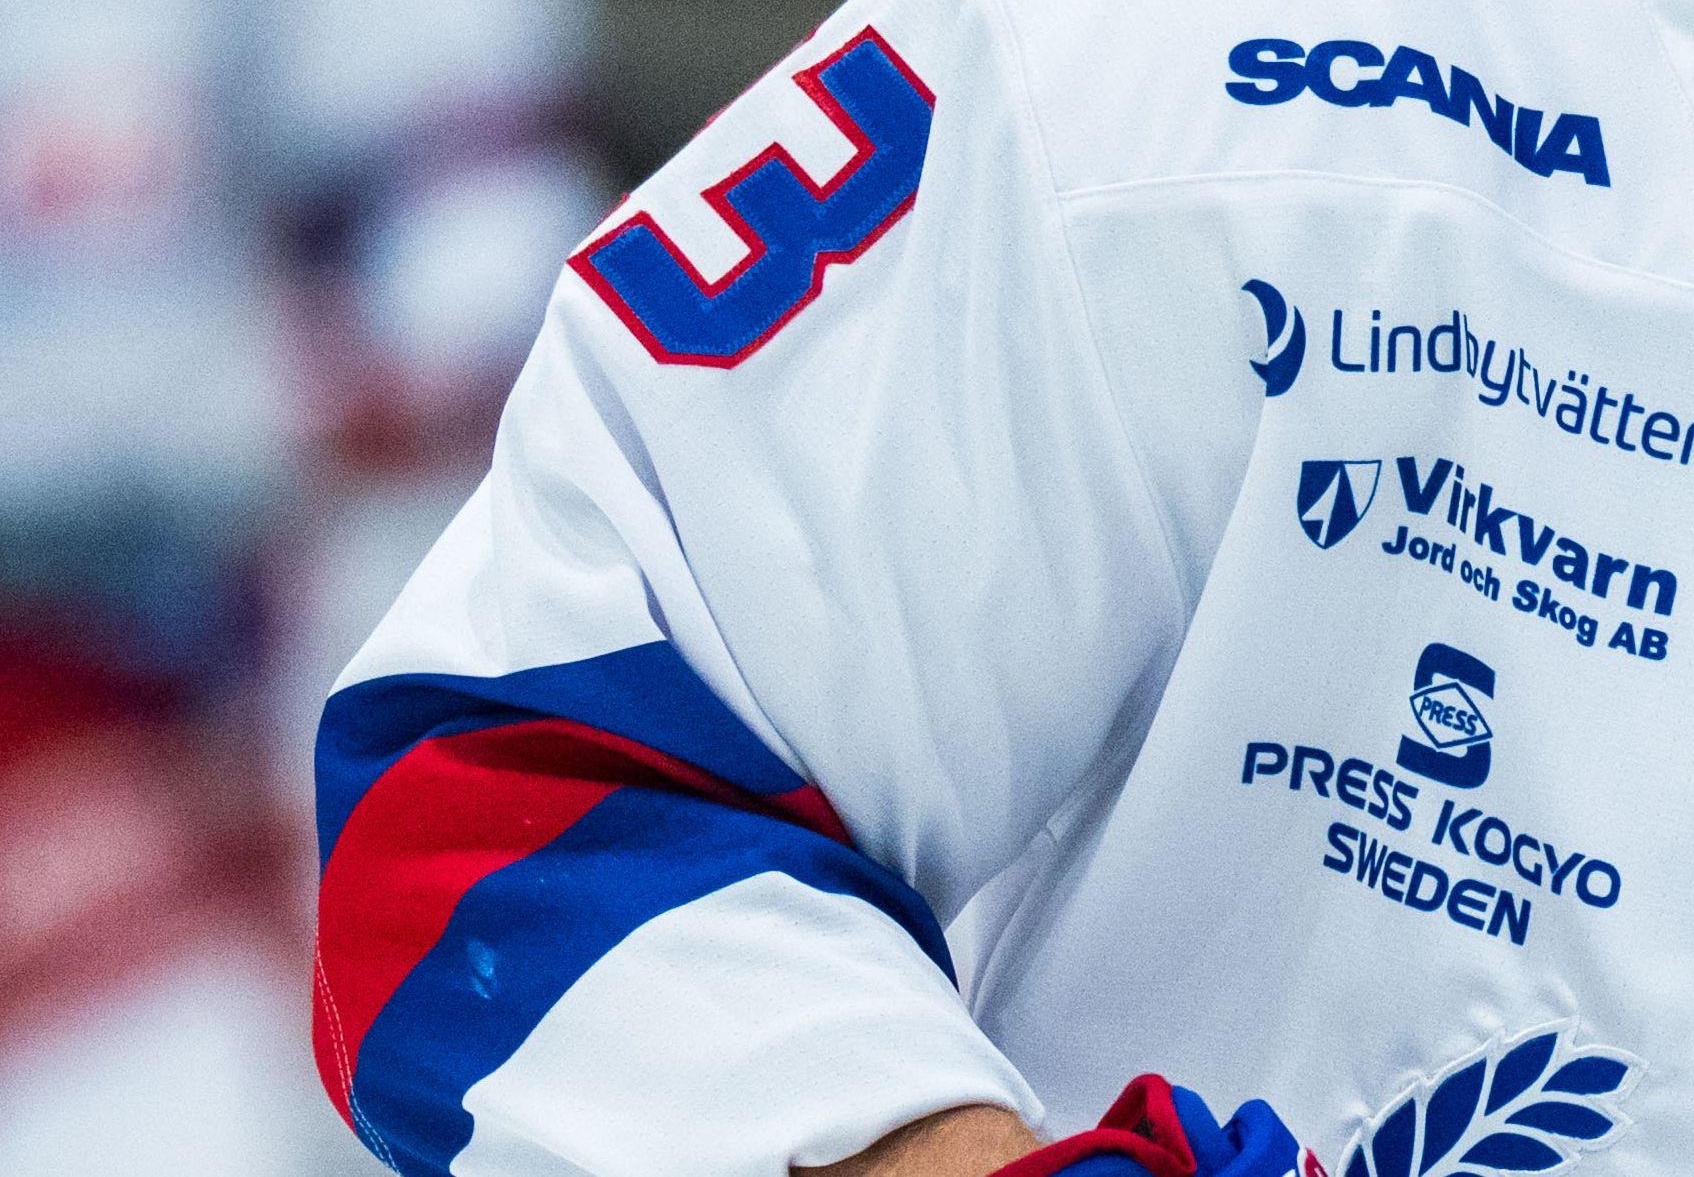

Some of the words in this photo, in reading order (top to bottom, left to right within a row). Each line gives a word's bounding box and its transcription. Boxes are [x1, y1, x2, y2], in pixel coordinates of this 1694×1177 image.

[1225, 37, 1612, 188] SCANIA
[566, 24, 937, 370] 3
[1381, 525, 1457, 574] Jord
[1460, 559, 1501, 602] och
[1512, 579, 1599, 648] Skog
[1607, 621, 1669, 661] AB
[1396, 456, 1678, 616] Virkvarn
[1418, 696, 1478, 737] PRESS
[1242, 742, 1420, 831] PRESS
[1431, 799, 1622, 909] KOGYO
[1323, 821, 1532, 947] SWEDEN
